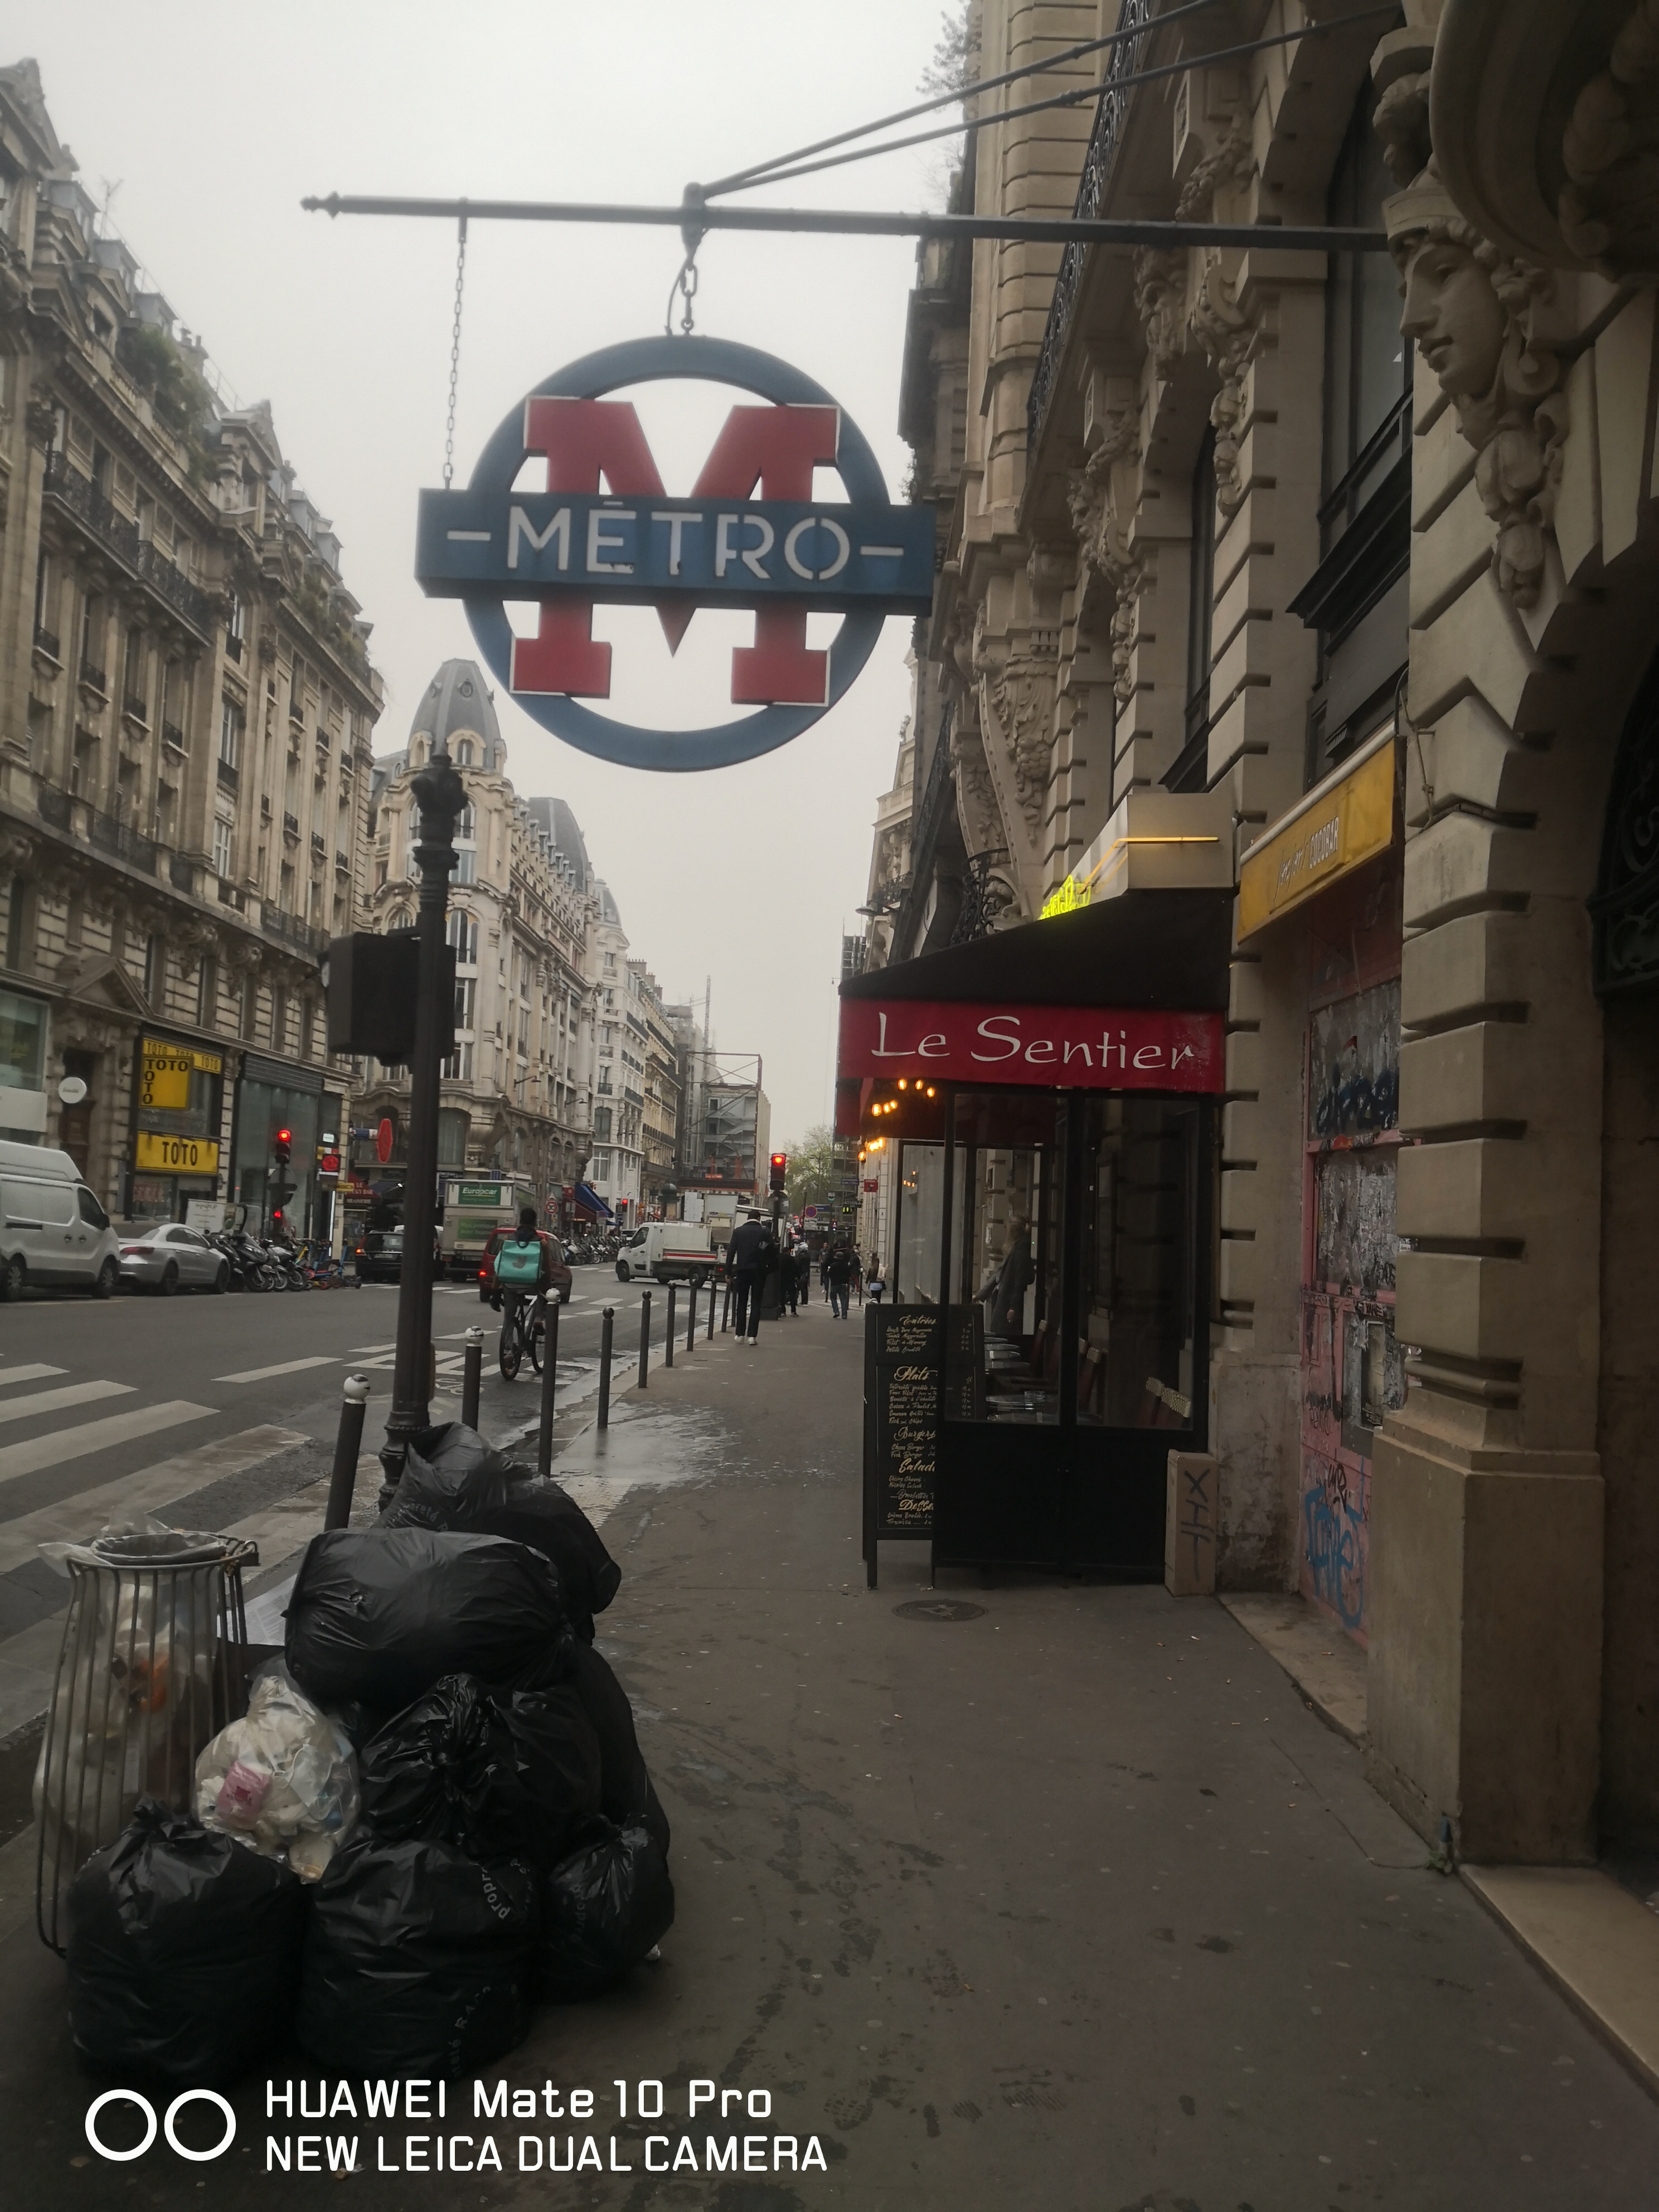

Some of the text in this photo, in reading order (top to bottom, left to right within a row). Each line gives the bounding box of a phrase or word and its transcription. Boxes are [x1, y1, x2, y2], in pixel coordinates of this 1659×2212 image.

[1309, 816, 1339, 870] COCOBAR
[871, 1012, 1195, 1070] Le Sentier
[145, 1059, 188, 1072] TOTO
[147, 1042, 167, 1055] TOTO
[201, 1056, 219, 1070] TOTO
[162, 1141, 198, 1166] TOTO
[462, 1187, 498, 1196] Europcar
[894, 1365, 938, 1382] Plats
[893, 1425, 936, 1442] Burgers
